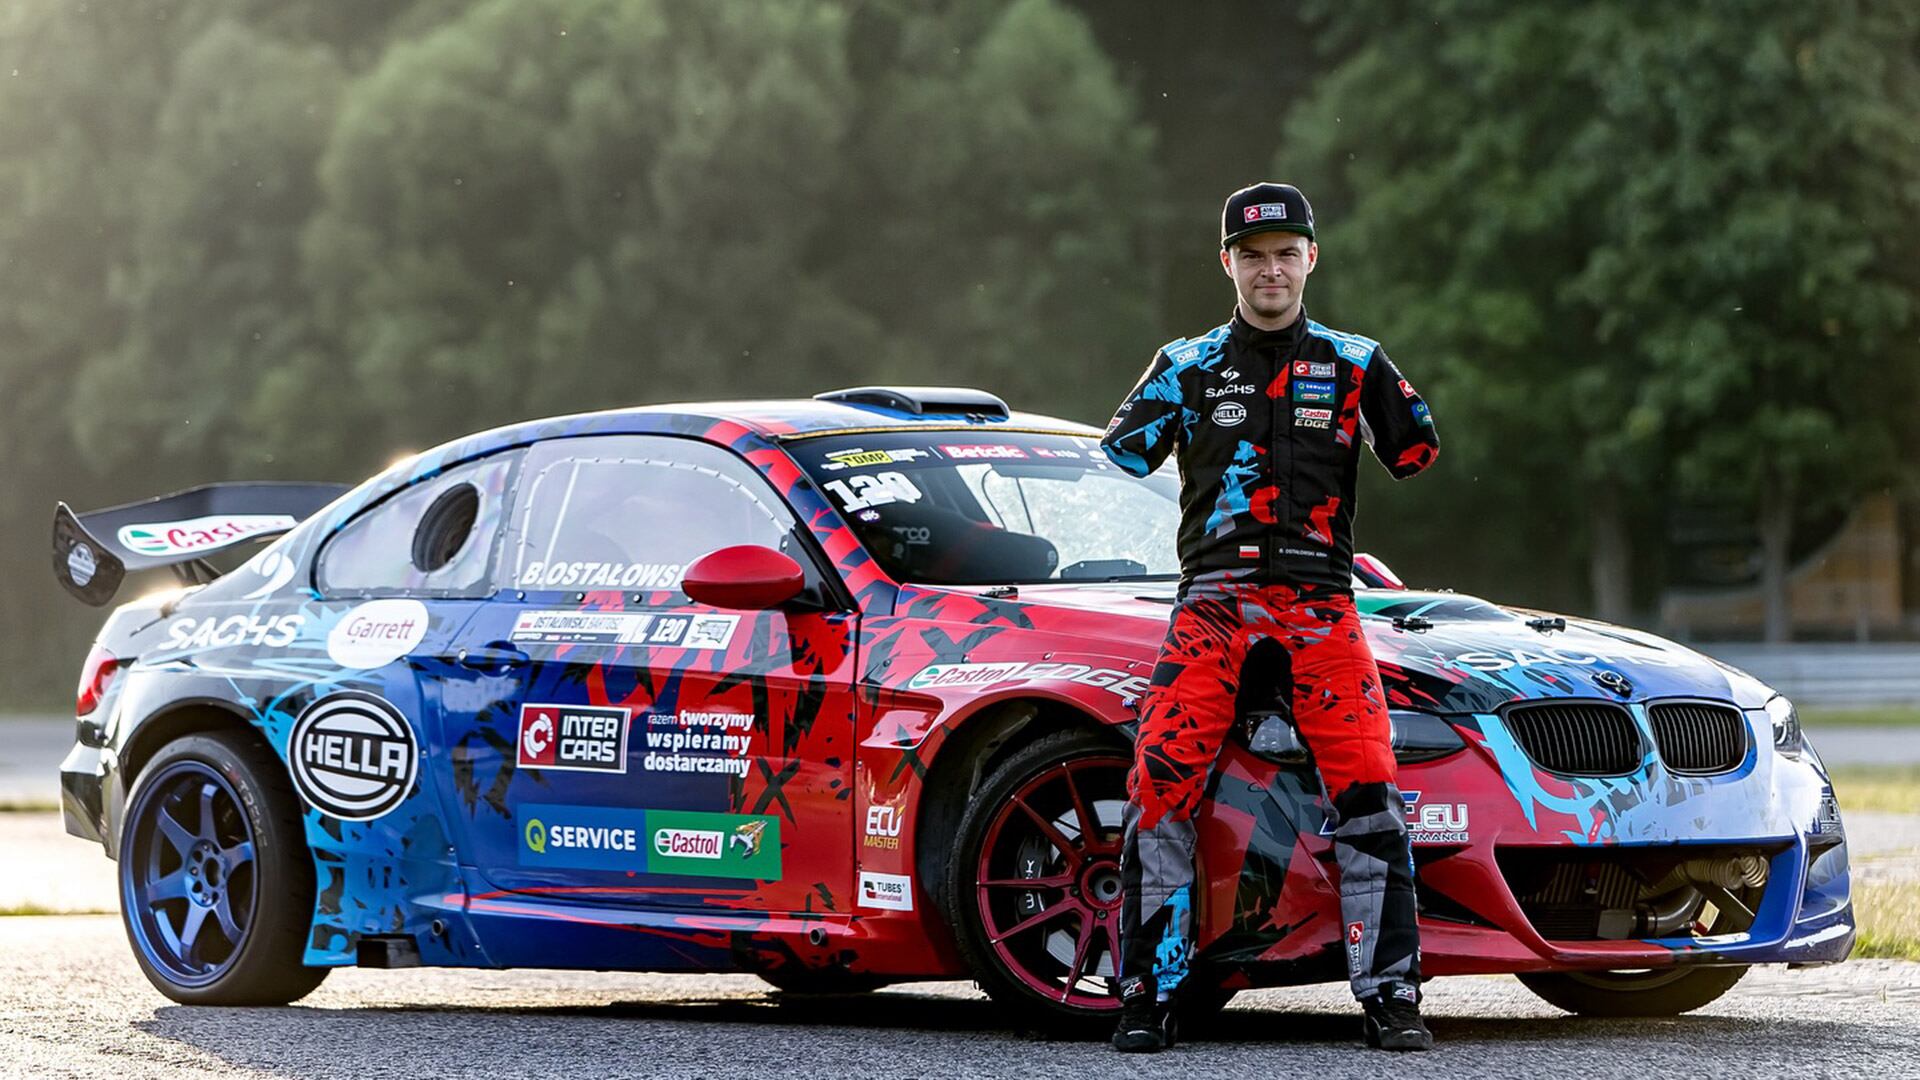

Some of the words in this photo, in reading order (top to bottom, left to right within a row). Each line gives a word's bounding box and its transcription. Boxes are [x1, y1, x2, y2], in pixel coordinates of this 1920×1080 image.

[1205, 384, 1256, 398] SACHS
[1214, 408, 1247, 419] HELLA
[1294, 418, 1330, 429] EDGE
[1303, 409, 1330, 419] Castrol
[823, 470, 923, 514] 120
[157, 614, 307, 650] SACHS
[346, 616, 416, 640] Garrett
[649, 617, 688, 642] 120
[932, 664, 1018, 685] Castrol
[1007, 662, 1152, 699] EDGE
[561, 714, 618, 739] INTER
[647, 713, 678, 725] razem
[679, 709, 755, 731] tworzymy
[560, 738, 616, 763] CARS
[646, 730, 751, 754] wspieramy
[304, 731, 409, 780] HELLA
[644, 752, 751, 778] dostarczamy
[865, 805, 903, 837] ECU
[550, 825, 637, 852] SERVICE
[671, 832, 719, 855] Castrol
[863, 835, 900, 850] MASTER
[876, 881, 902, 894] TUBES
